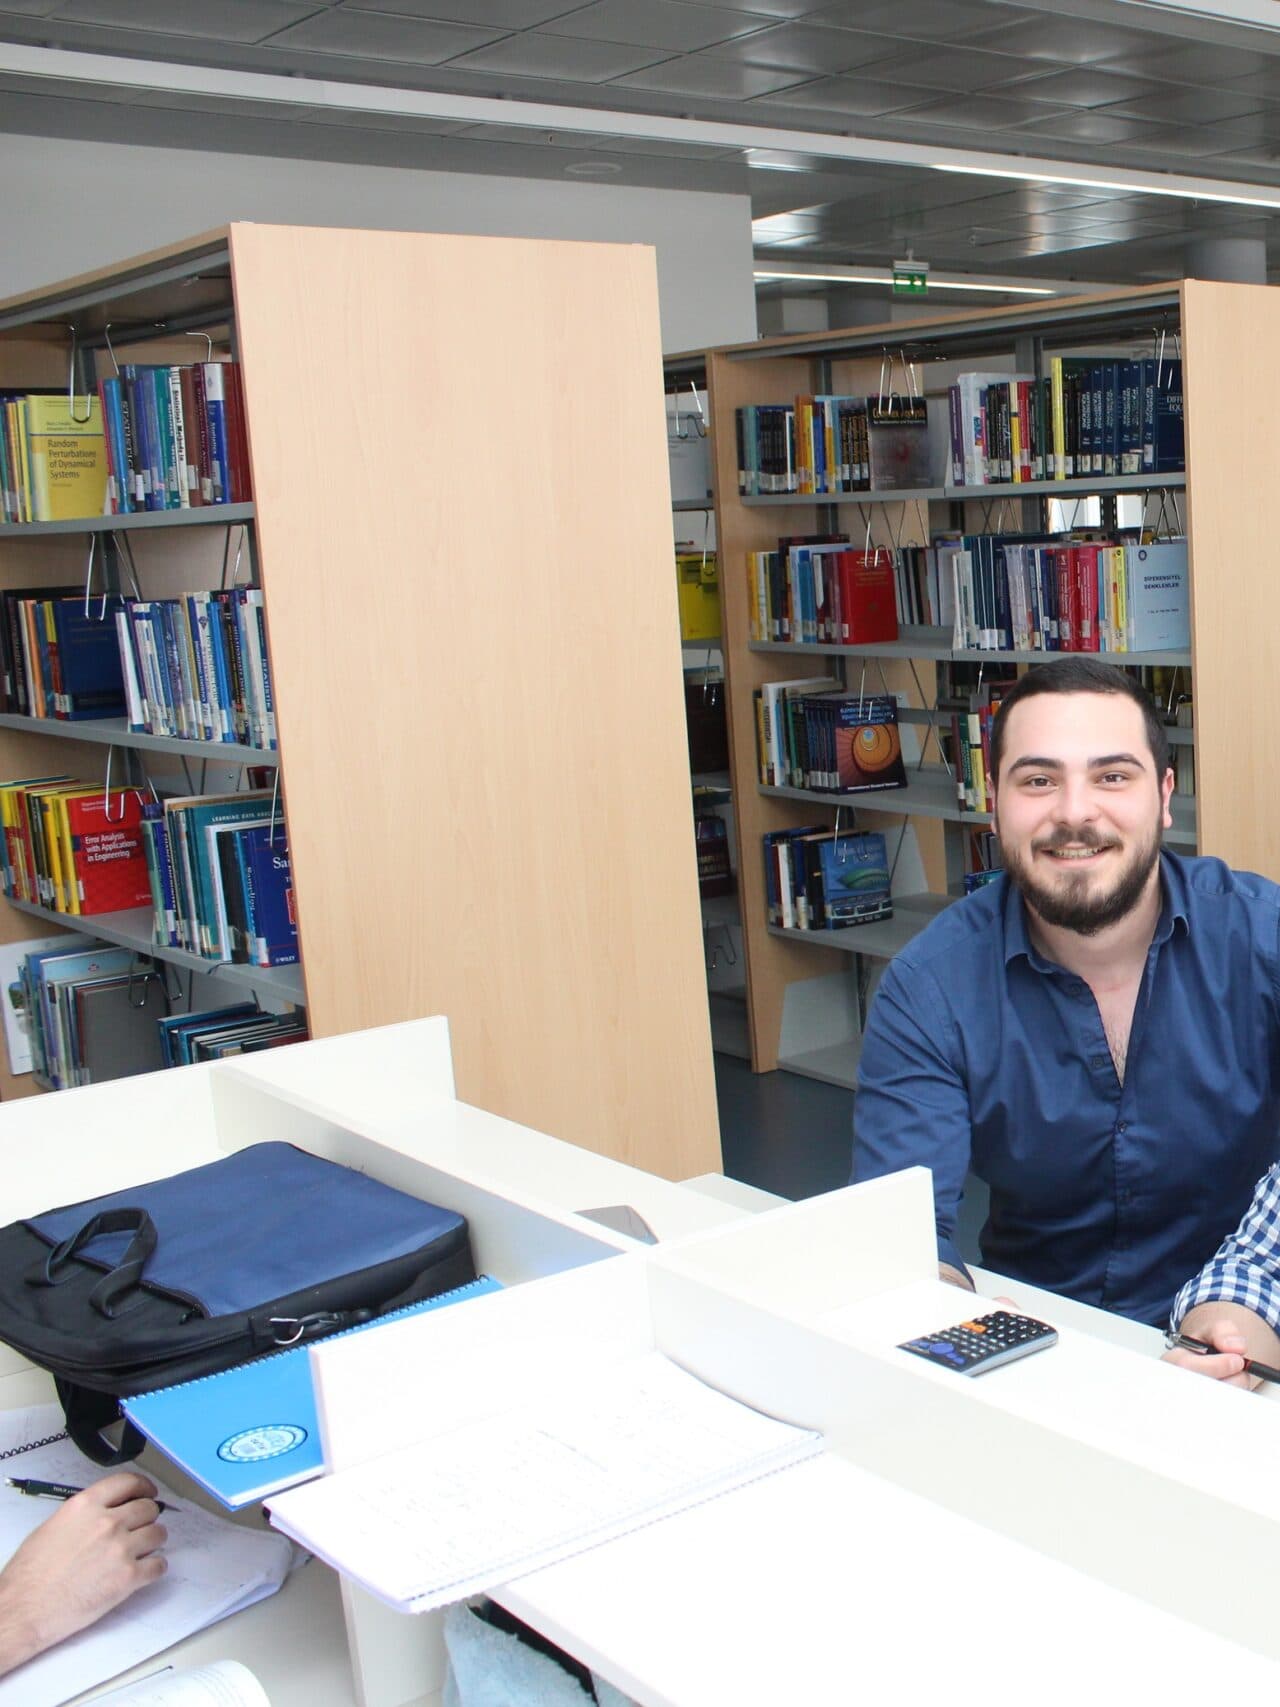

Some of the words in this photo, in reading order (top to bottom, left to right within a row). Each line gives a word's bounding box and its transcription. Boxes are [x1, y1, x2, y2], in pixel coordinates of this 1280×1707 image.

[121, 400, 134, 469] STATISTIC
[48, 439, 78, 448] Random
[49, 450, 97, 458] Perturbations
[50, 460, 58, 468] of
[59, 460, 96, 470] Dynamical
[51, 470, 80, 480] Systems
[85, 836, 100, 845] Error
[101, 832, 125, 843] Analysis
[87, 844, 101, 853] with
[101, 840, 137, 852] Applications
[94, 850, 130, 862] Engineering
[280, 955, 295, 963] WILEY
